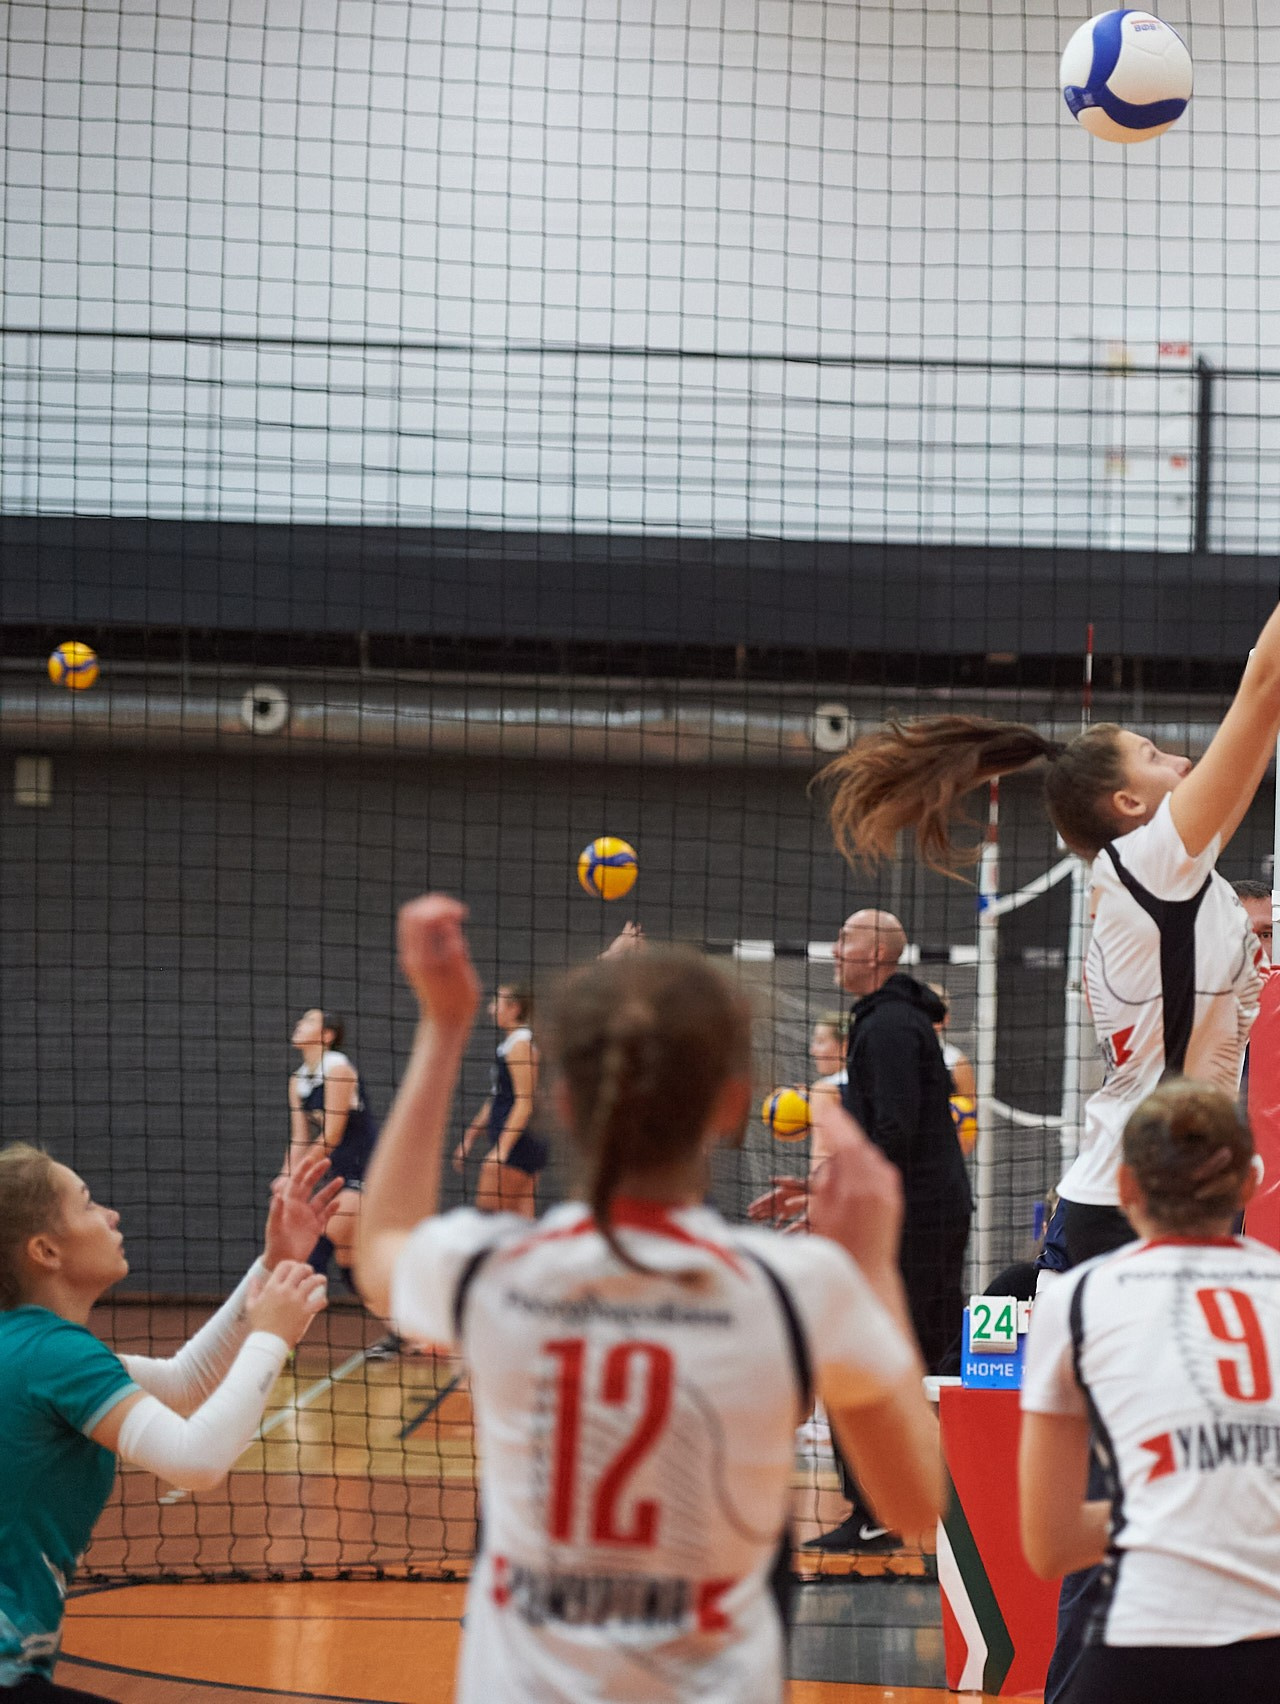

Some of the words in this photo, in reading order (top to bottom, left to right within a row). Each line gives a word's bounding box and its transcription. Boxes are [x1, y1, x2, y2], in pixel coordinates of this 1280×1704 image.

[972, 1304, 1014, 1340] 24
[1196, 1287, 1272, 1403] 9
[966, 1362, 1014, 1377] HOME
[543, 1337, 677, 1548] 12
